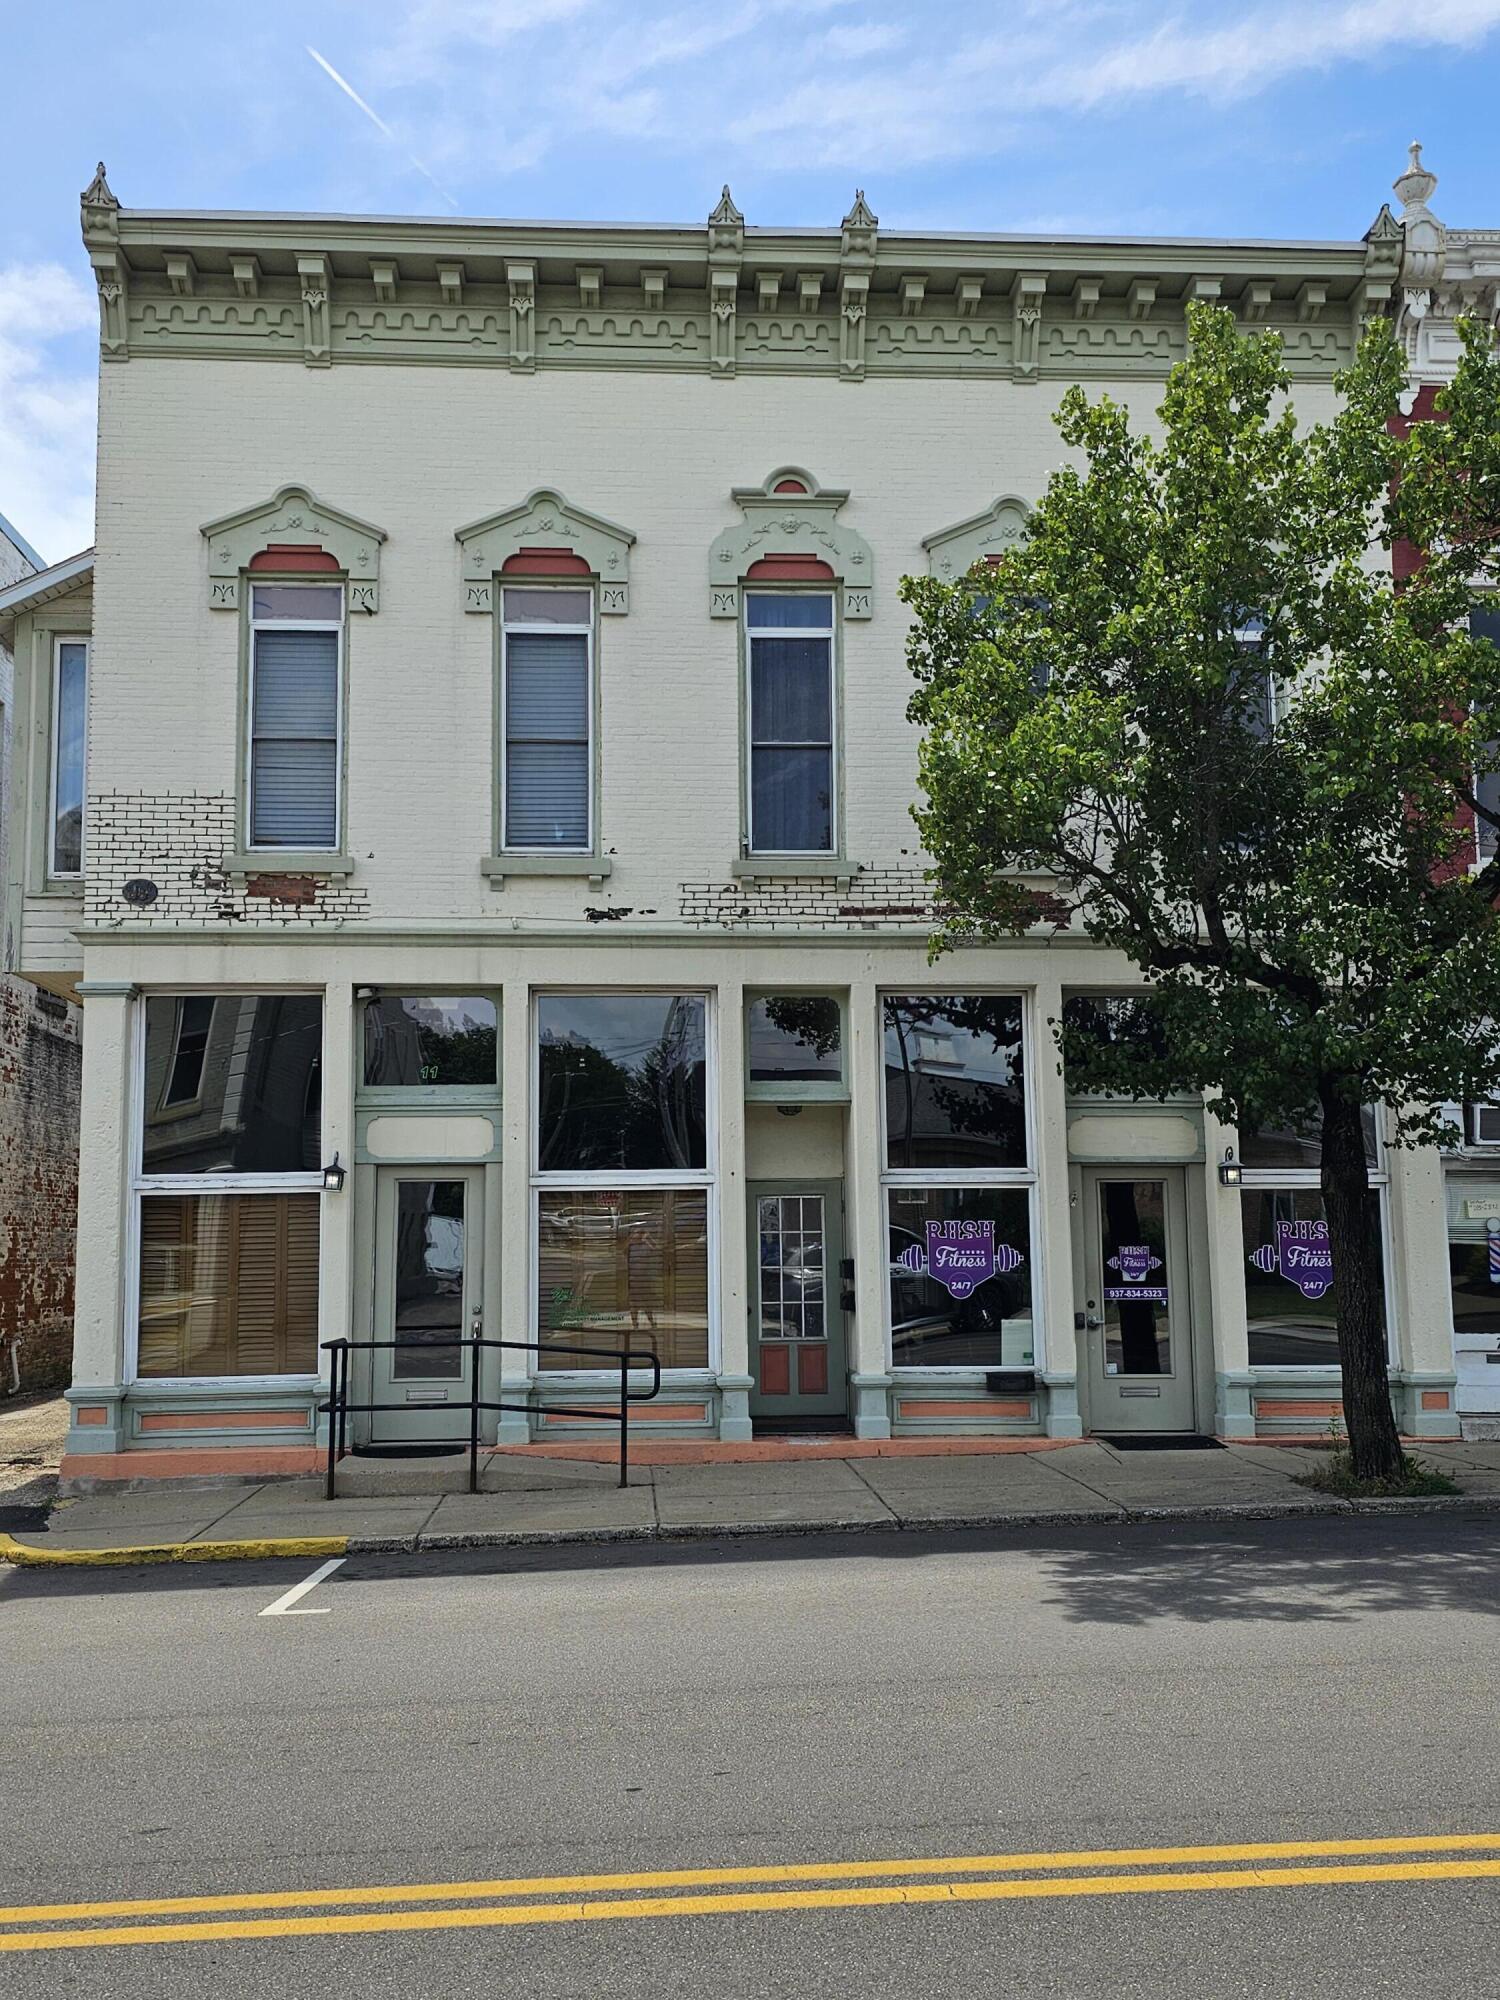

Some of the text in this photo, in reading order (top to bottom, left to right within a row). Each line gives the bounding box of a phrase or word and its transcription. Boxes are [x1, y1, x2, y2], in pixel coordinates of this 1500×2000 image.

[925, 1220, 996, 1240] RUSH
[1276, 1220, 1330, 1240] RUS
[935, 1245, 987, 1268] Fitness
[1287, 1245, 1333, 1268] Fitnes
[951, 1281, 972, 1290] 24/7
[1109, 1289, 1163, 1298] 937-834-5323
[1303, 1281, 1324, 1290] 24/7
